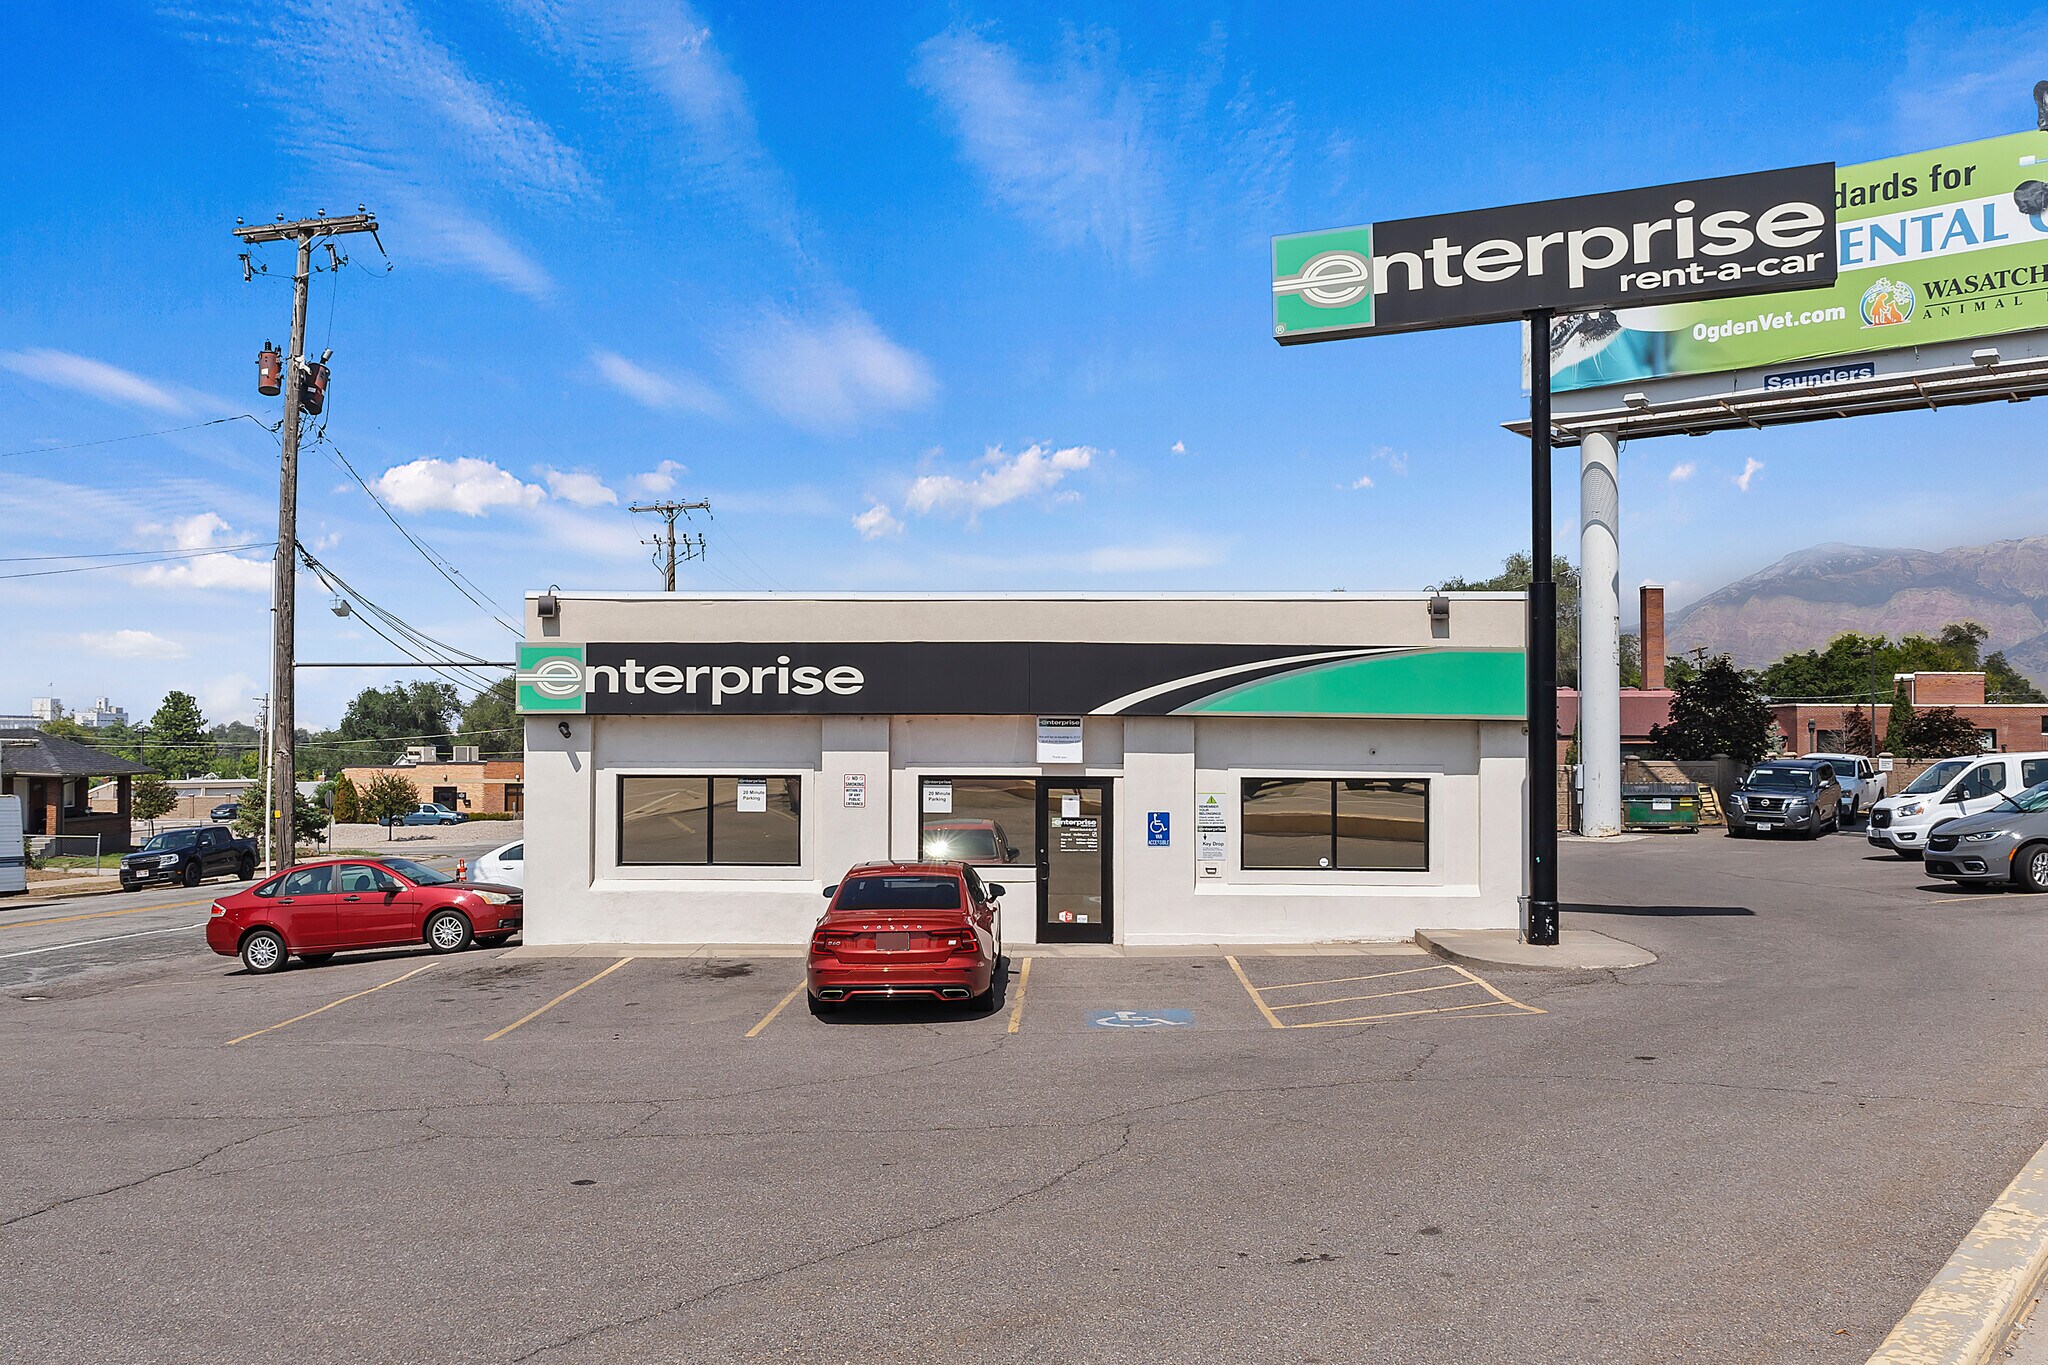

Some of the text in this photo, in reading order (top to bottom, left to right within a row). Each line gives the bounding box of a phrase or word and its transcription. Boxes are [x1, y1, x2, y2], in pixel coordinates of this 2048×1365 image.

[1928, 163, 1977, 193] for
[1272, 199, 1826, 304] enterprise
[1839, 202, 2009, 266] ENTAL
[1619, 251, 1826, 292] rent-a-car
[1922, 264, 2048, 300] WASATCH
[1692, 306, 1846, 343] OgdenVet.com
[1922, 296, 2023, 319] ANIMAL
[1766, 366, 1874, 391] Saunders
[517, 655, 865, 706] enterprise
[1052, 819, 1097, 827] enterprise
